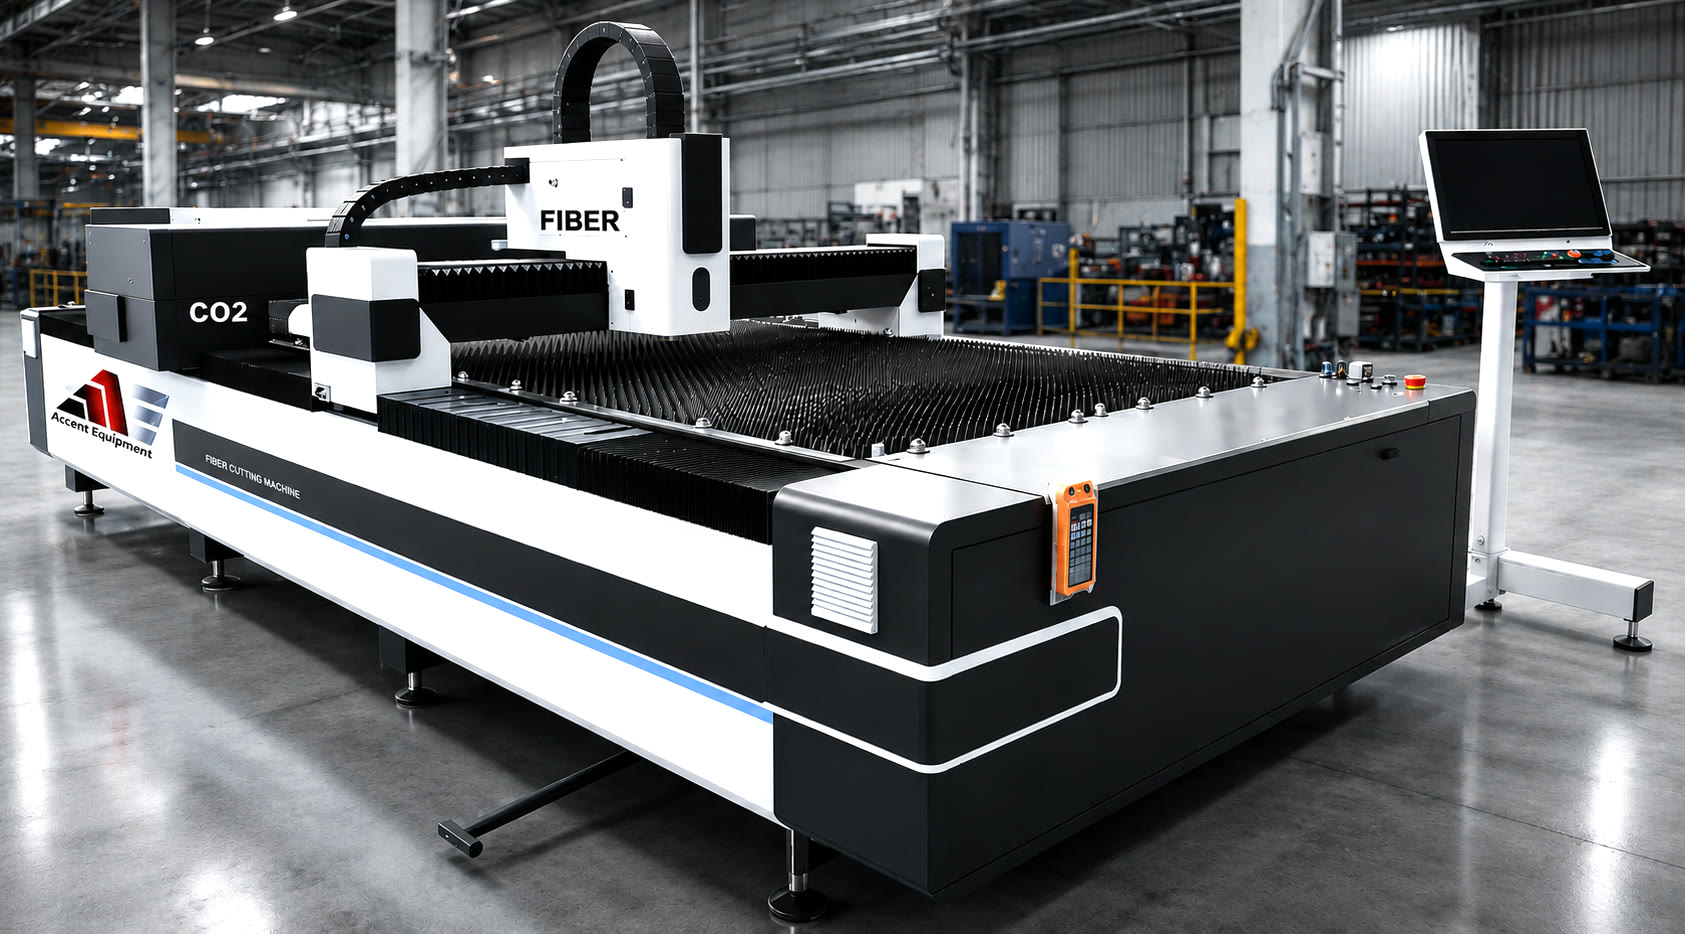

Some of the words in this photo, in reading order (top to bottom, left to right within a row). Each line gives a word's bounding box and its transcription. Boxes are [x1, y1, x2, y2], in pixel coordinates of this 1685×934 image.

[541, 210, 620, 231] FIBER
[190, 301, 248, 322] CO2
[51, 412, 89, 434] Accent
[92, 427, 152, 459] Equipment
[205, 454, 228, 470] FIBER
[229, 464, 262, 484] CUTTING
[263, 477, 300, 499] MACHINE
